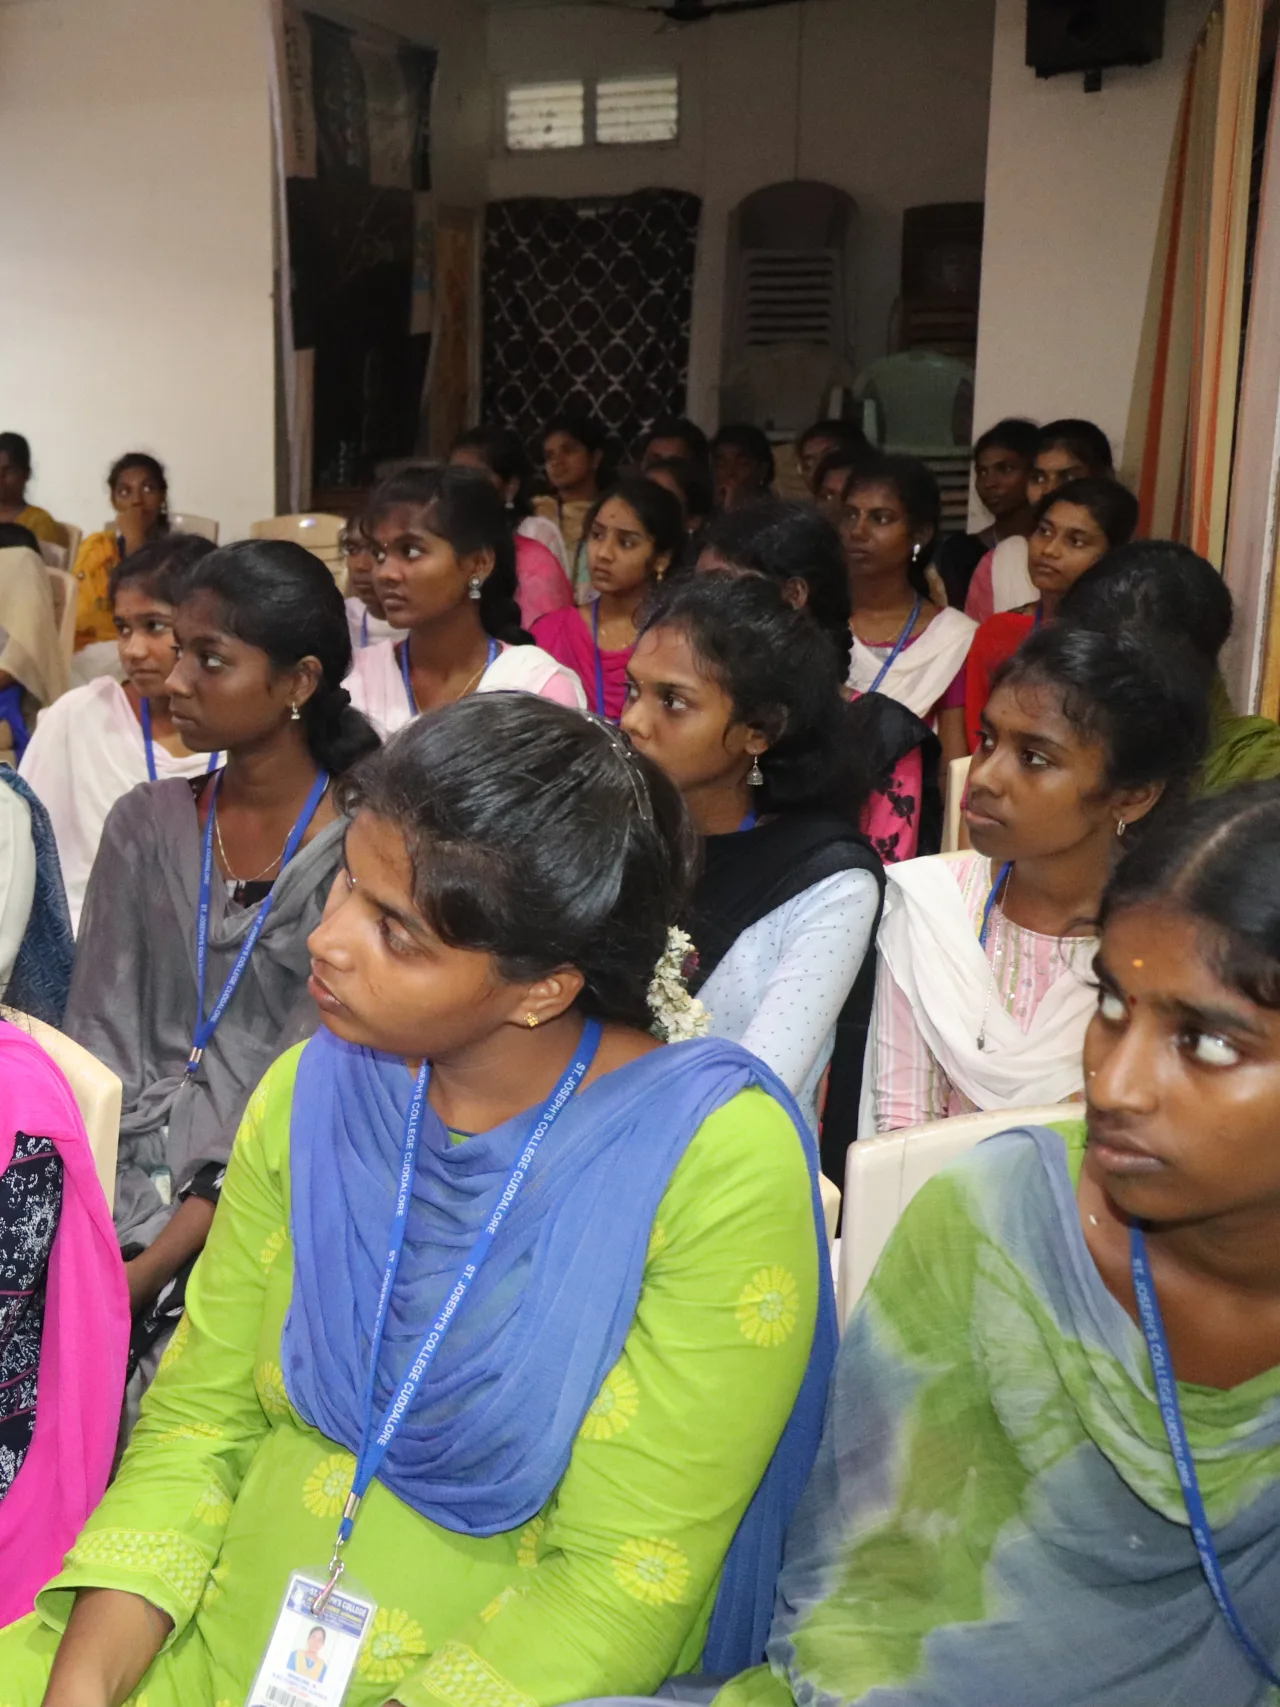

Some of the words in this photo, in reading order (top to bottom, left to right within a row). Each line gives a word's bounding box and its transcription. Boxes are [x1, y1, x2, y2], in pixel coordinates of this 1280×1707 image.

[228, 955, 246, 986] COLLEGE
[210, 985, 233, 1023] CUDDALORE
[571, 1062, 586, 1077] ST.
[543, 1076, 576, 1122] JOSEPH'S
[405, 1102, 421, 1150] COLLEGE
[517, 1121, 549, 1170] COLLEGE
[395, 1152, 413, 1217] CUDDALORE
[485, 1170, 524, 1235] CUDDALORE
[461, 1263, 476, 1280] ST.
[434, 1281, 466, 1331] JOSEPH'S
[408, 1332, 439, 1382] COLLEGE
[1150, 1344, 1173, 1406] COLLEGE
[376, 1382, 415, 1447] CUDDALORE
